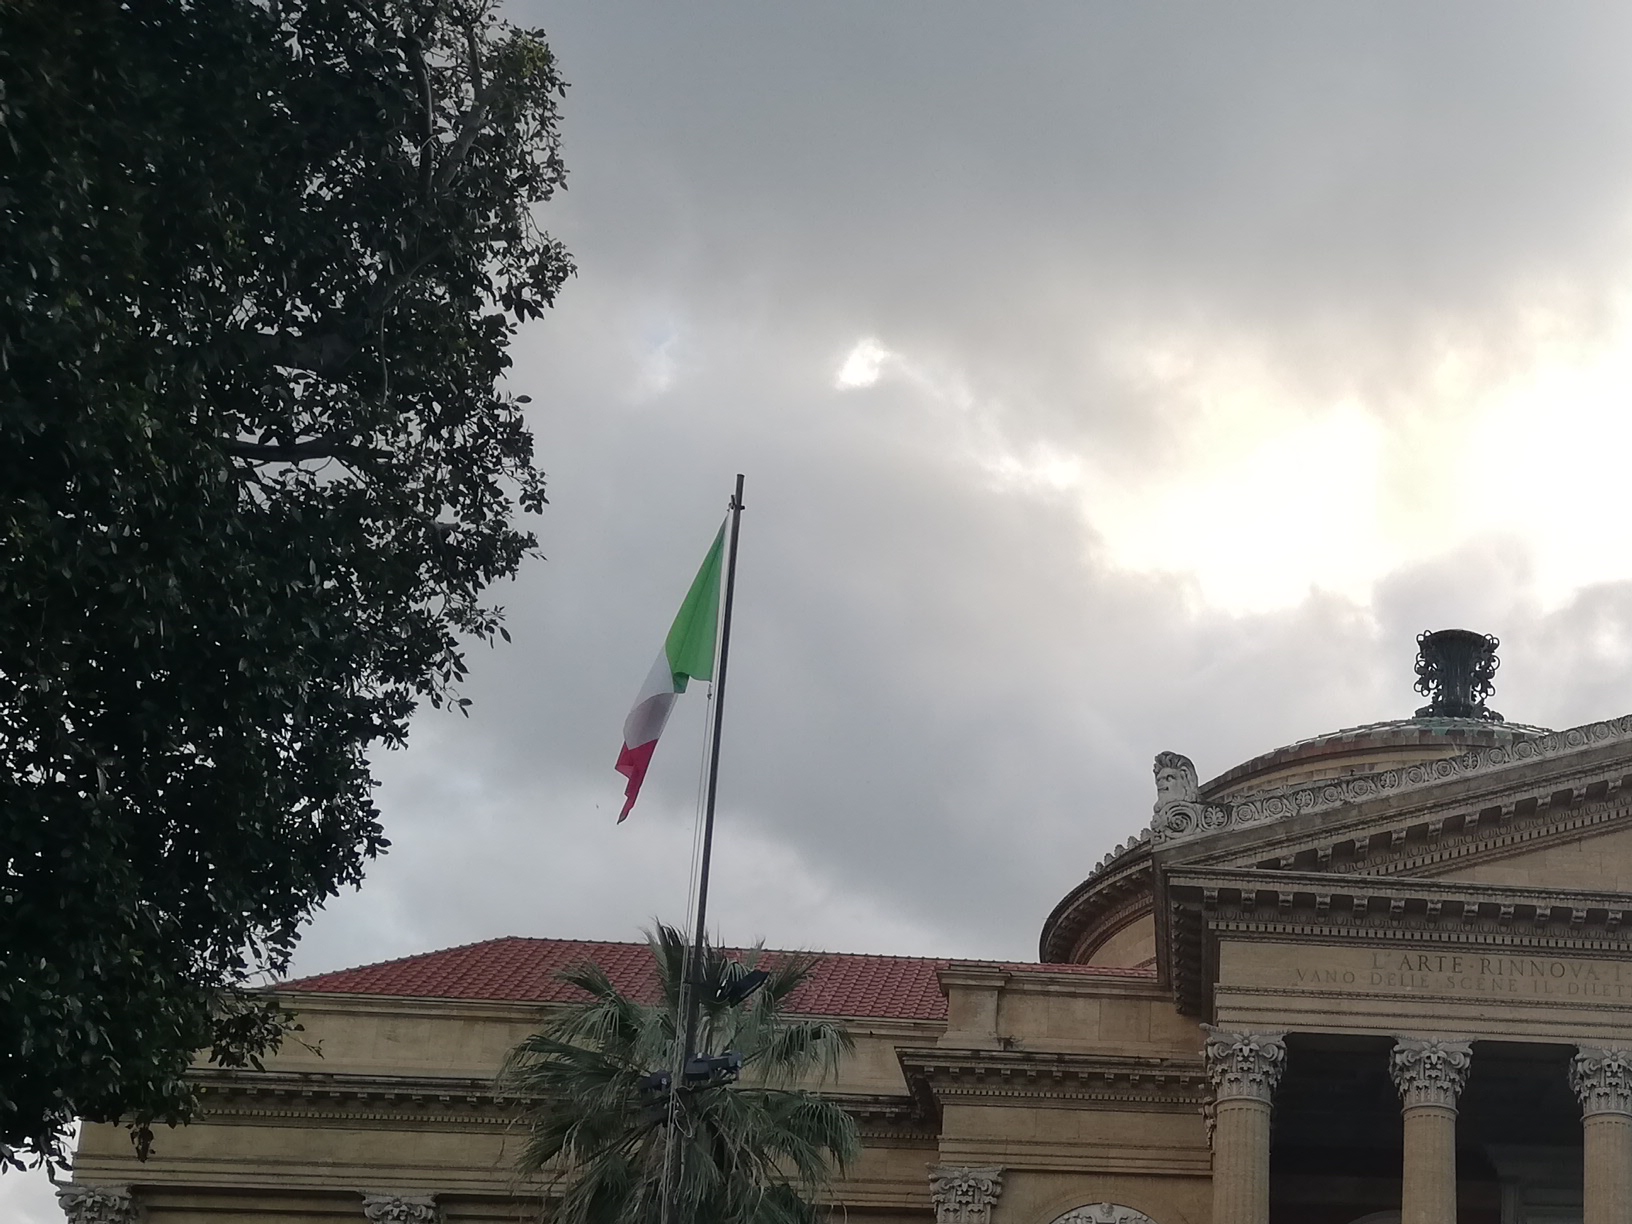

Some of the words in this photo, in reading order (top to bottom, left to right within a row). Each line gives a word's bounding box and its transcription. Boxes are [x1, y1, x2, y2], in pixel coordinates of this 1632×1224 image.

[1296, 968, 1356, 985] VANO
[1370, 971, 1431, 988] DELLE
[1446, 974, 1518, 993] SCENE
[1533, 979, 1554, 995] IL
[1480, 957, 1601, 981] RINNOVA
